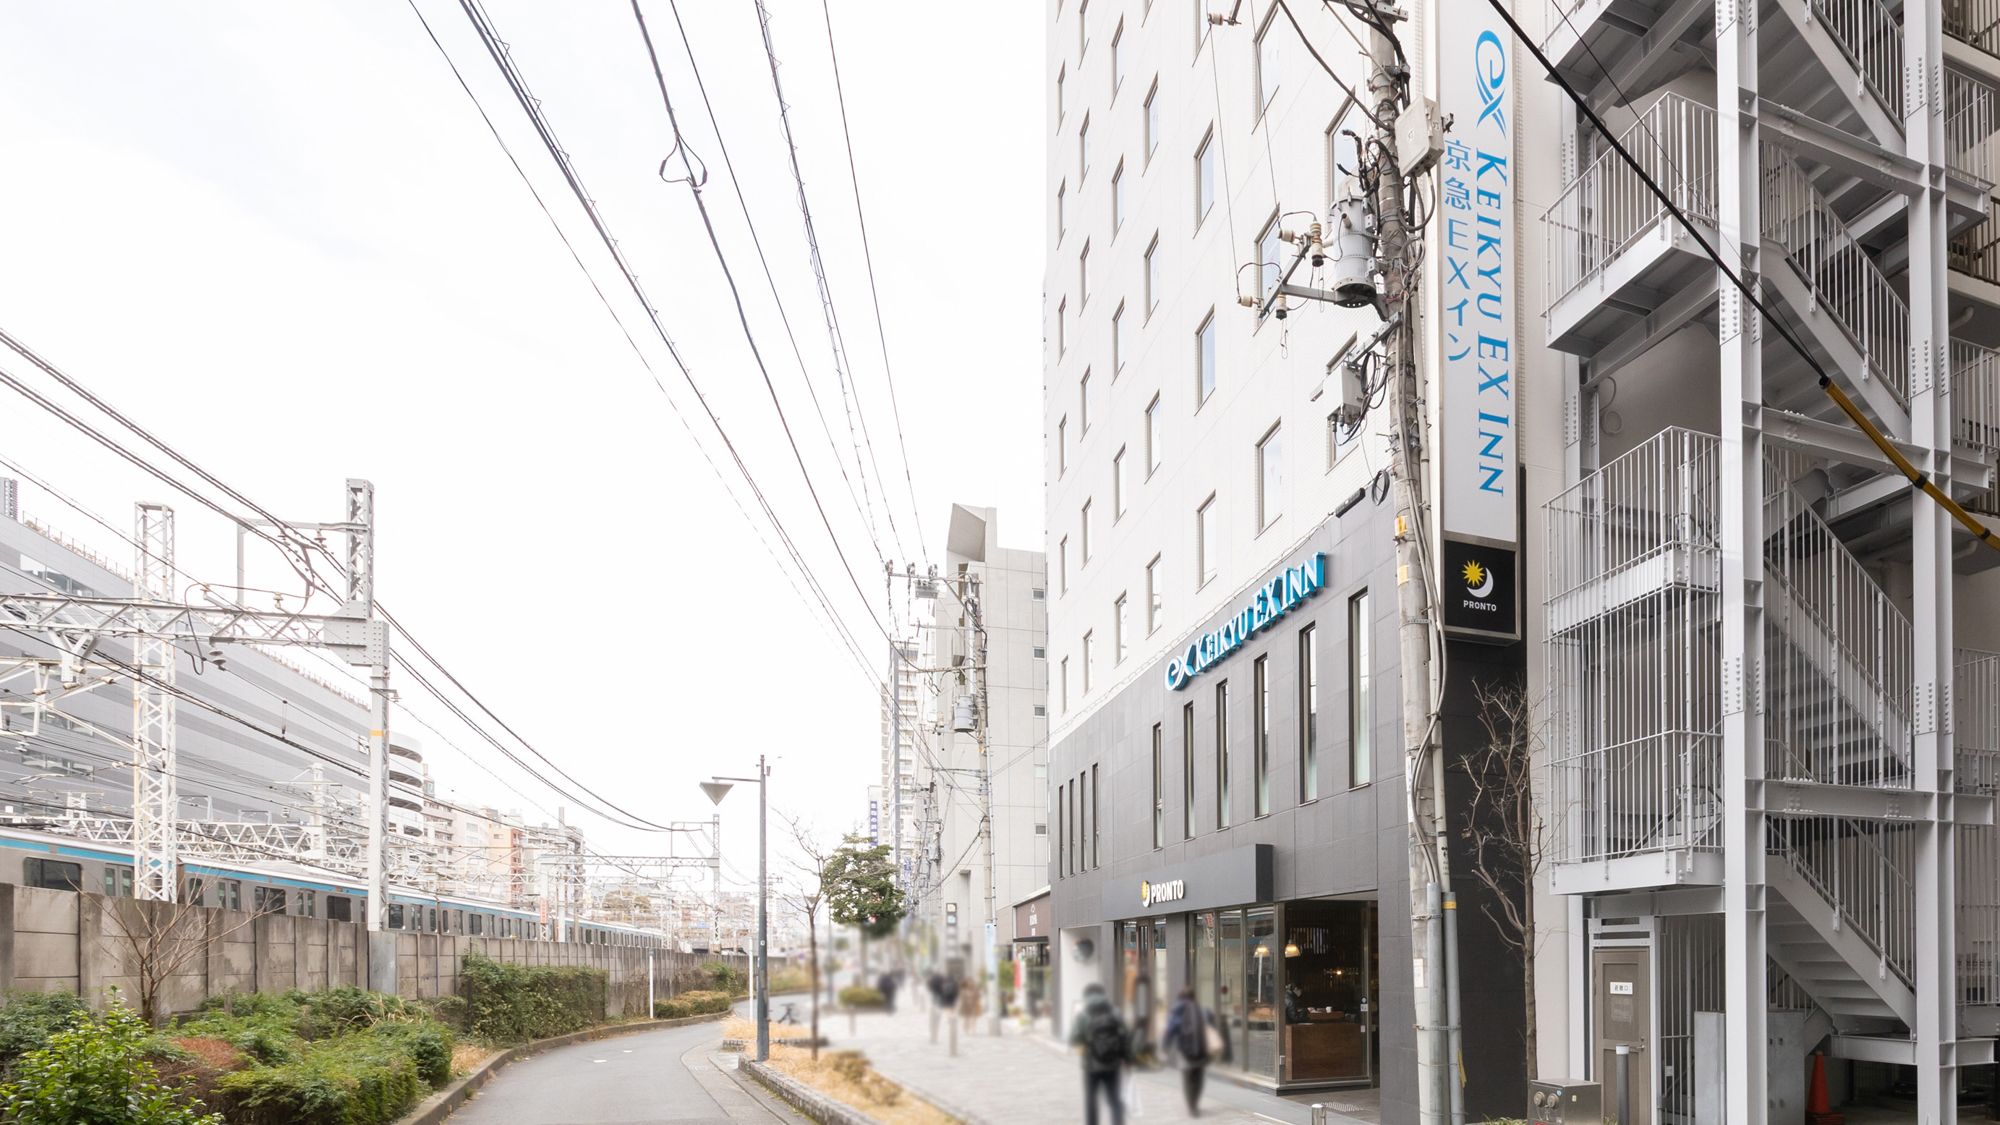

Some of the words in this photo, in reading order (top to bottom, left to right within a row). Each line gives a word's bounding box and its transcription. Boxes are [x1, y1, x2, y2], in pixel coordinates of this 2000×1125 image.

[1444, 139, 1472, 362] 京急EXイン
[1476, 147, 1508, 323] KEIKYU
[1477, 331, 1509, 400] EX
[1478, 408, 1509, 497] INN
[1195, 606, 1253, 673] KEIKYU
[1252, 576, 1283, 632] EX
[1282, 552, 1326, 611] INN
[1463, 600, 1497, 612] PRONTO
[1151, 879, 1184, 904] PRONTO
